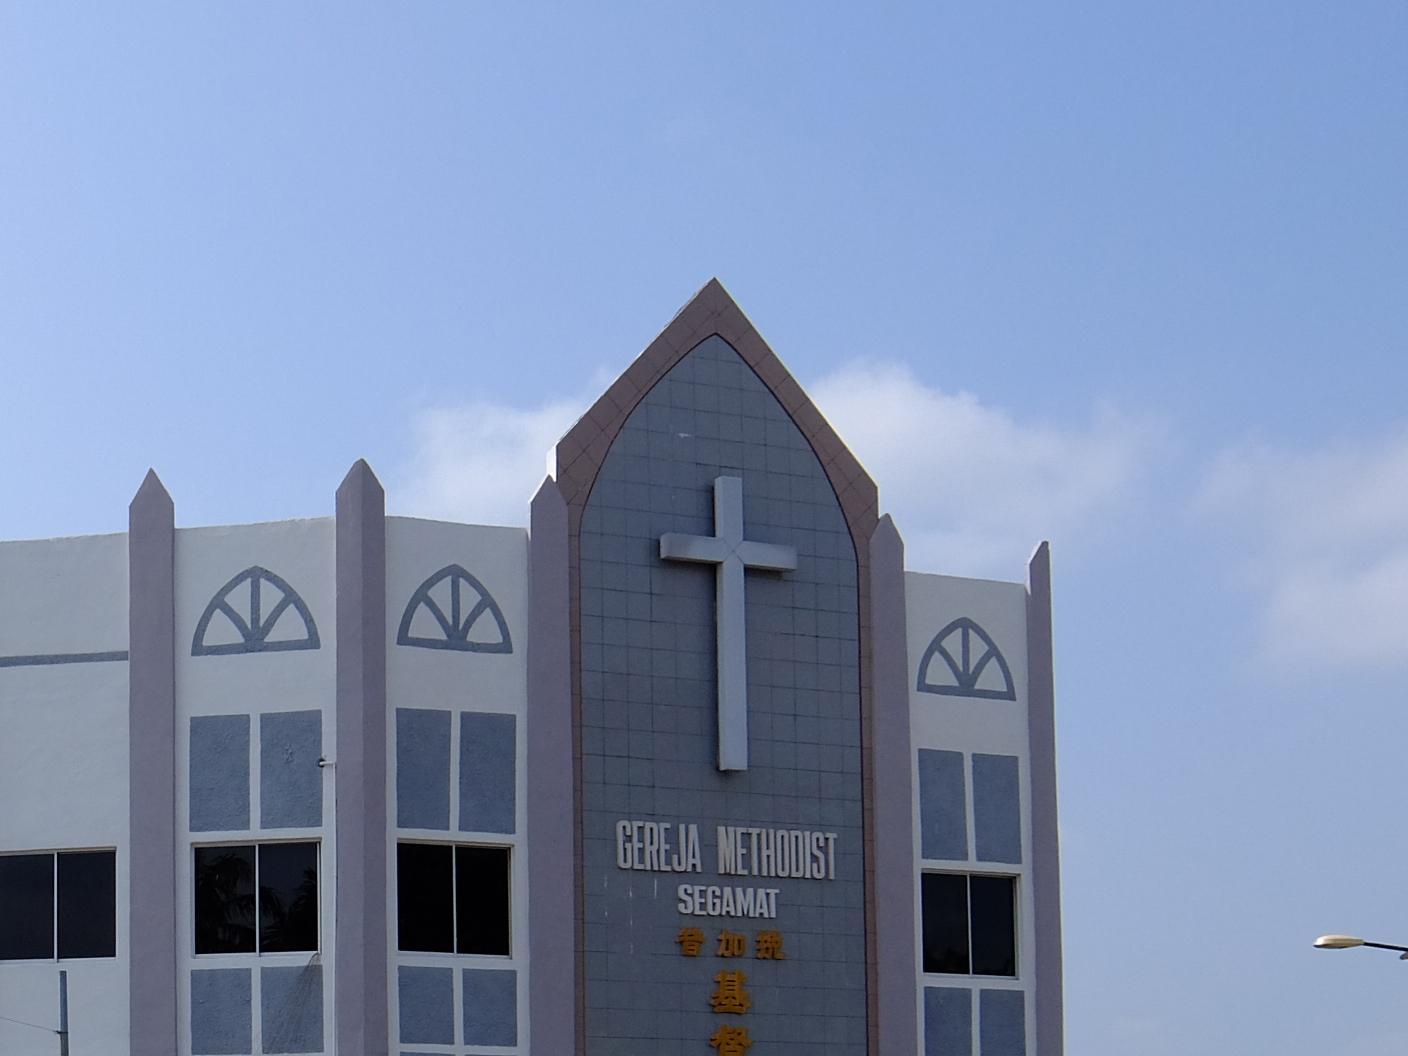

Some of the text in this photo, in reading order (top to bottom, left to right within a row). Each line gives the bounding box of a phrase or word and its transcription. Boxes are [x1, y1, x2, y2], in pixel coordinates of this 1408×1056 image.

[616, 820, 837, 880] GEREJA METHODIST
[677, 884, 780, 918] SEGAMAT
